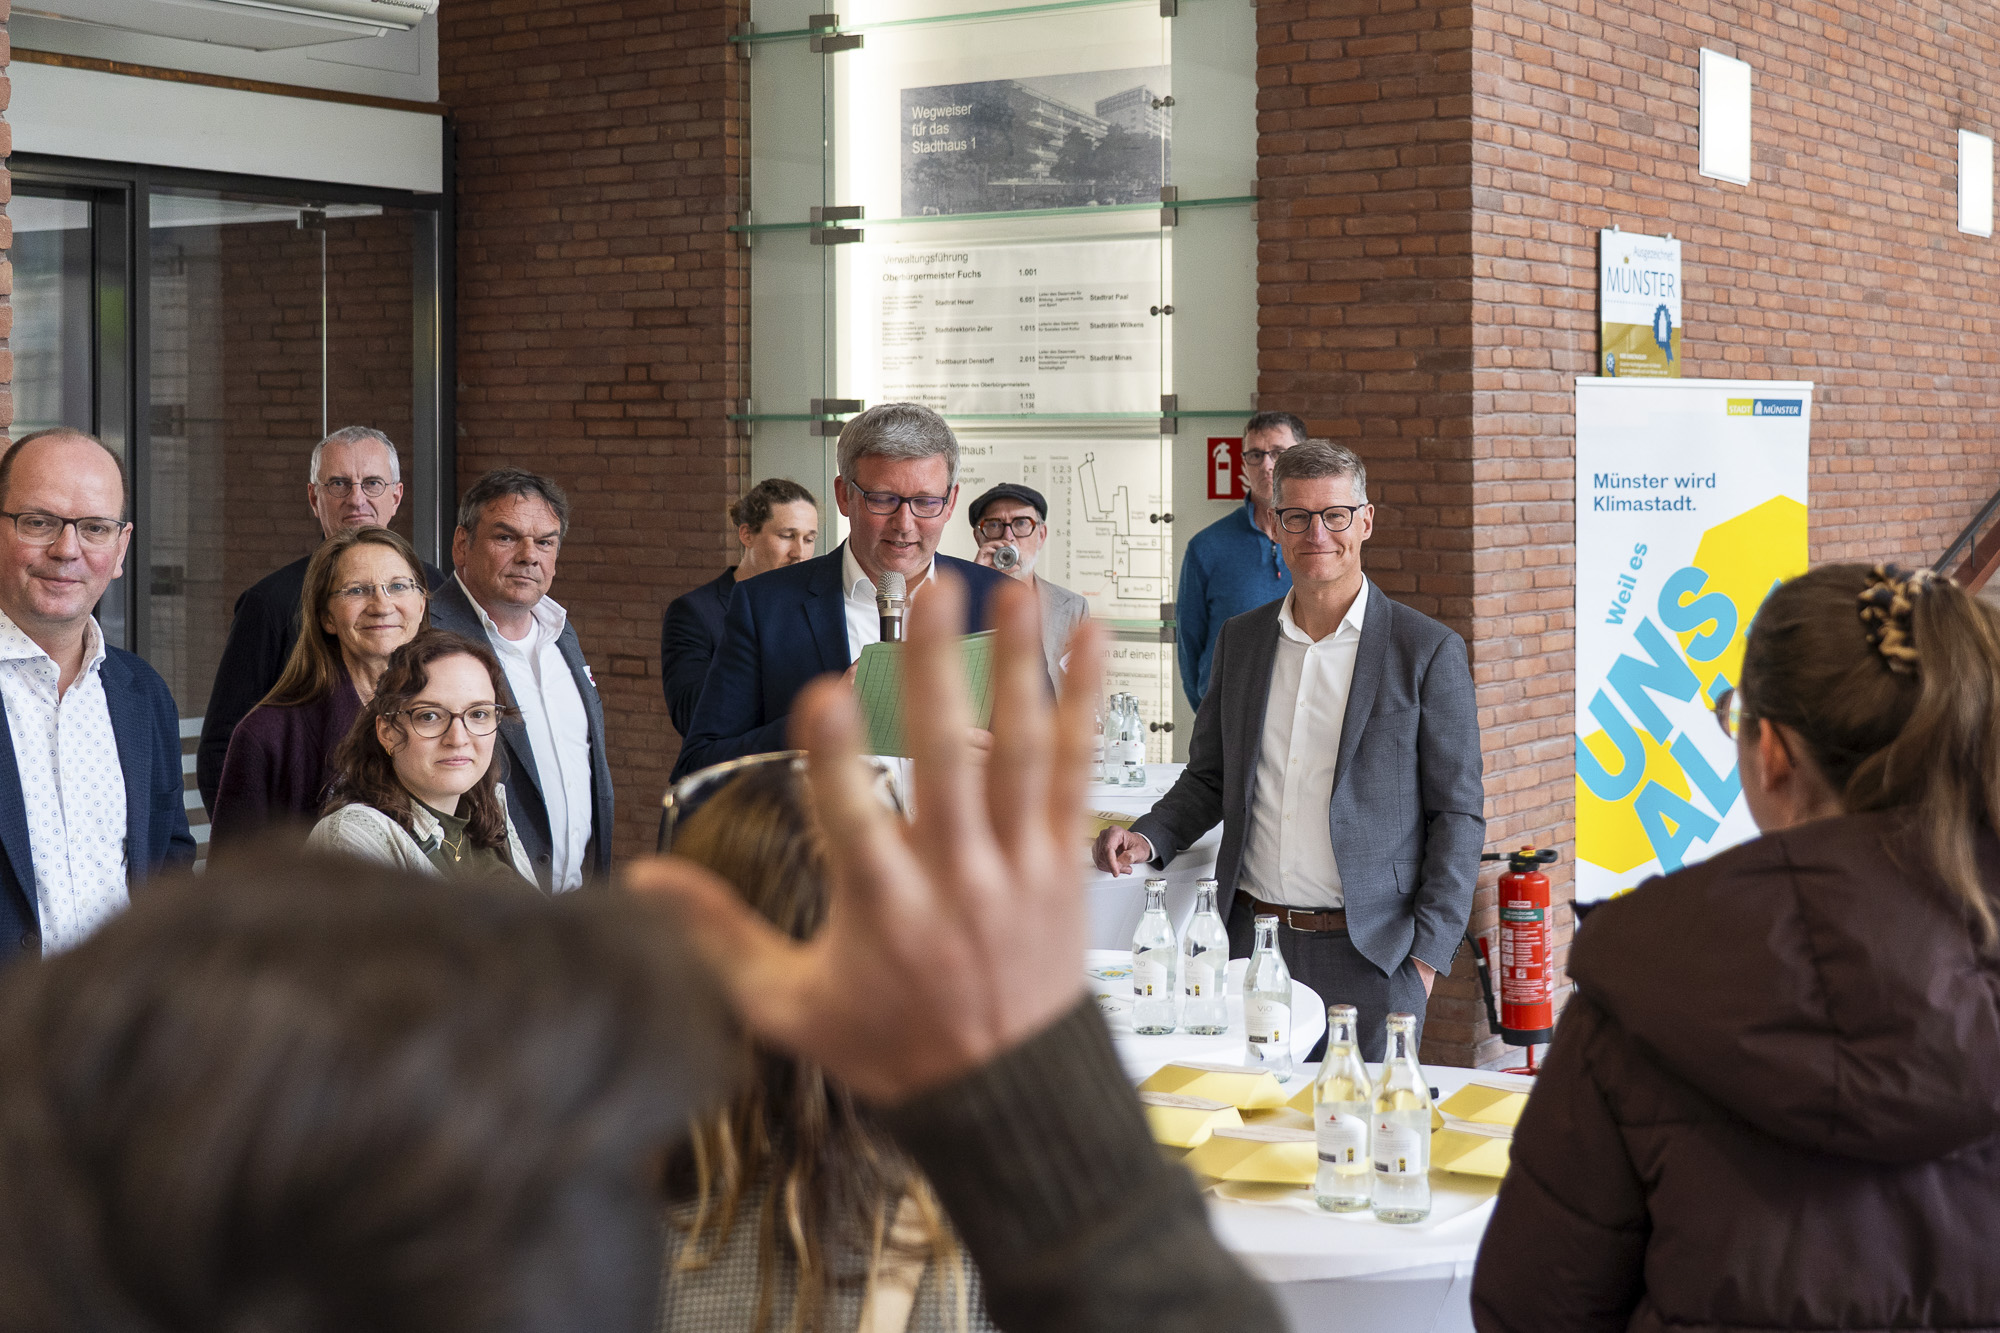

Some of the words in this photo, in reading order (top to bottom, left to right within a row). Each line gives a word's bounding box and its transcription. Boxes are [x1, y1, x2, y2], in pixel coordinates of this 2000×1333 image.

[912, 104, 972, 121] Wegweiser
[912, 121, 927, 137] für
[930, 122, 949, 136] das
[912, 139, 967, 154] Stadthaus
[971, 137, 976, 150] 1
[884, 252, 968, 265] Verwaltungsführung
[883, 272, 955, 282] Oberbürgermeister
[957, 270, 982, 279] Fuchs
[1019, 268, 1037, 276] 1.001
[935, 358, 968, 366] Stadtbaurat
[1728, 405, 1751, 414] STADT
[1763, 404, 1799, 415] MÜNSTER
[989, 445, 994, 455] 1
[1593, 472, 1668, 489] Münster
[1674, 472, 1716, 489] wird
[1593, 495, 1697, 512] Klimastadt.
[1118, 557, 1124, 566] A
[1605, 573, 1638, 627] Weil
[1629, 541, 1649, 571] es
[1112, 648, 1128, 659] auf
[1129, 648, 1157, 660] einen
[1575, 566, 1739, 803] UNS
